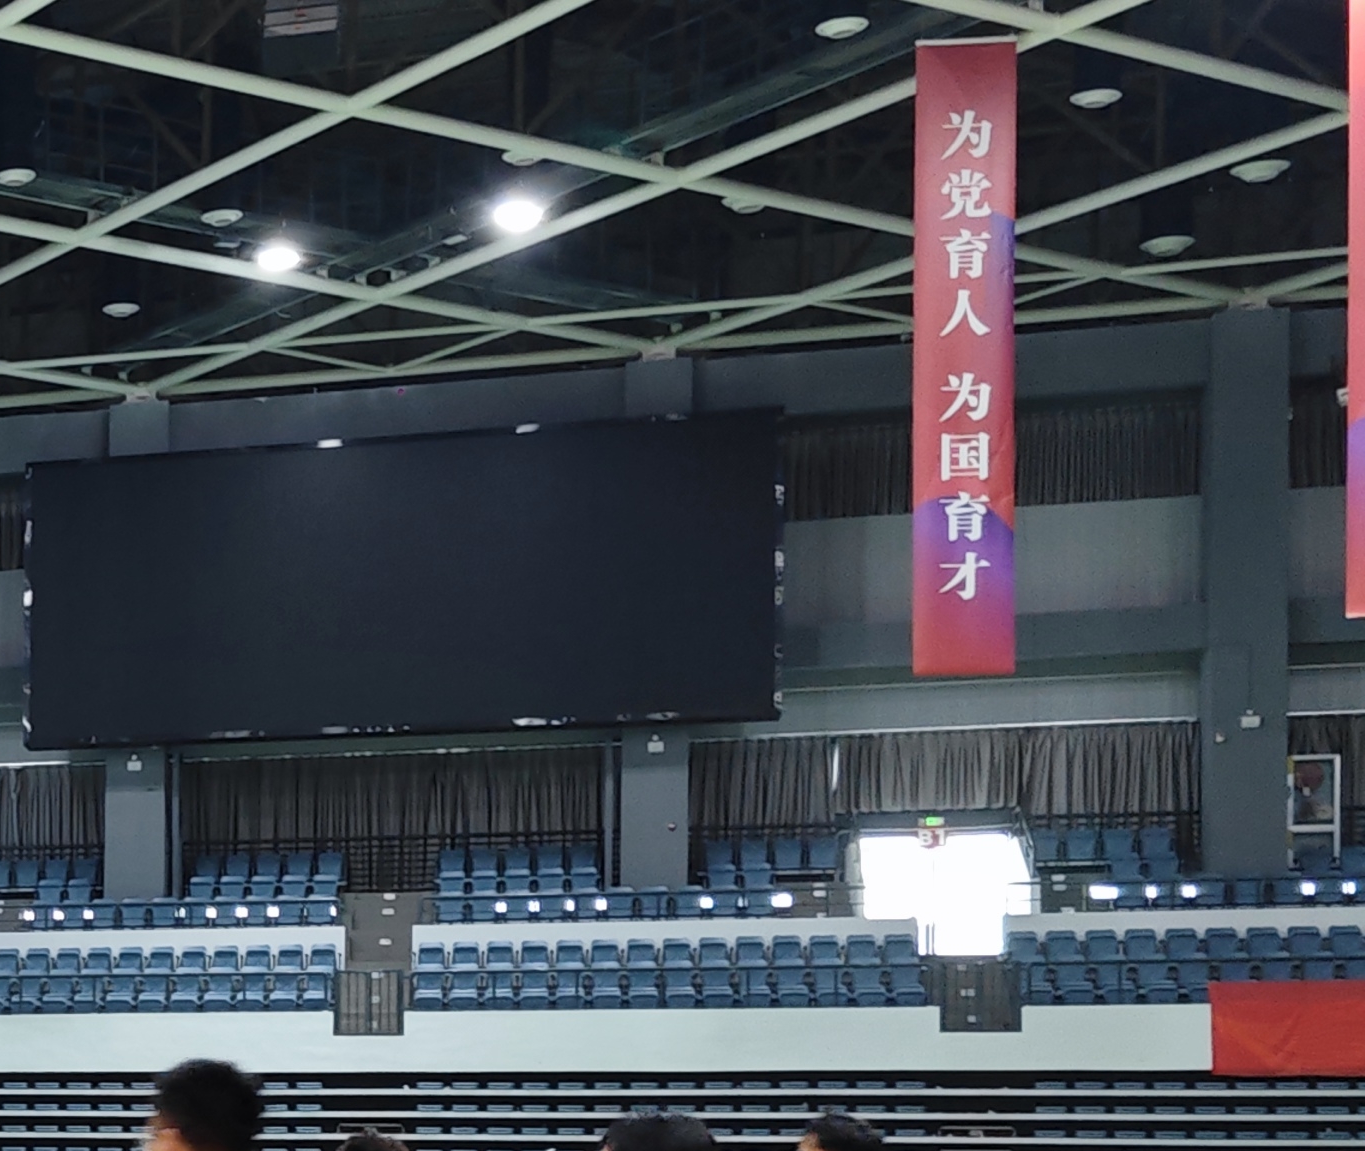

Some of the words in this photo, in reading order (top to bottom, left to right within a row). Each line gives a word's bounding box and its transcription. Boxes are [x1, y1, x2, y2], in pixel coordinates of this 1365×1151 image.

[938, 109, 994, 339] 为党育人
[938, 372, 994, 602] 为国育才
